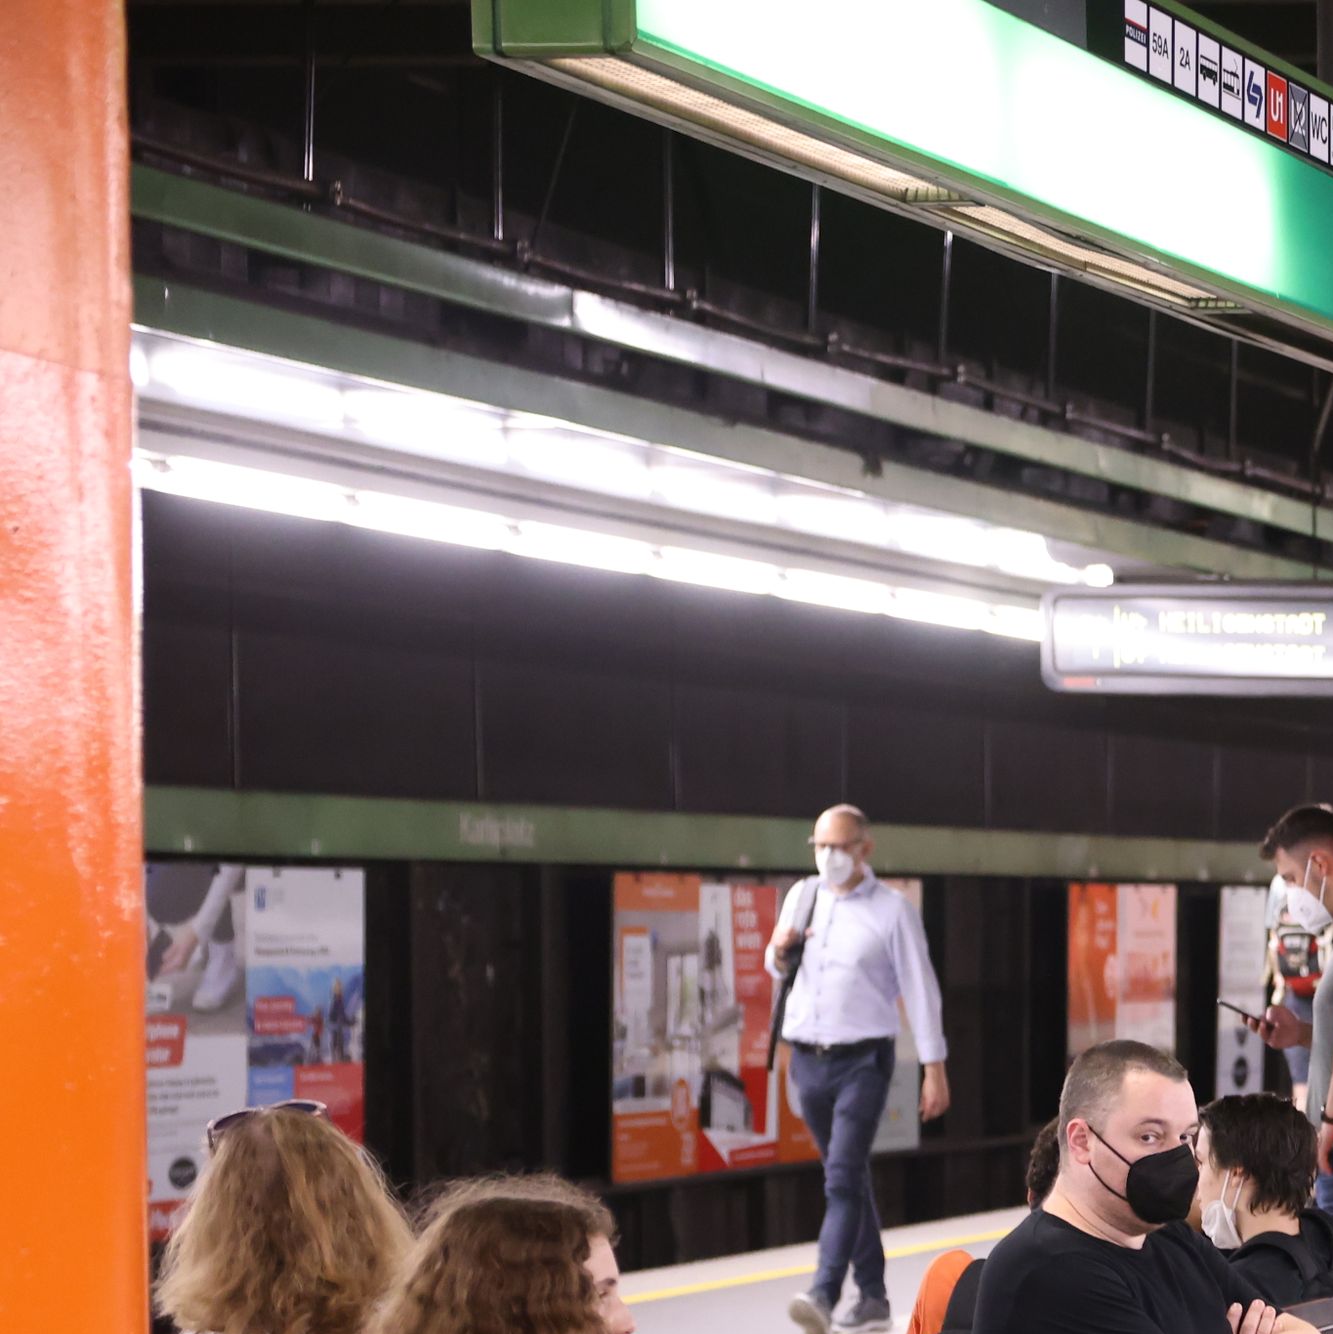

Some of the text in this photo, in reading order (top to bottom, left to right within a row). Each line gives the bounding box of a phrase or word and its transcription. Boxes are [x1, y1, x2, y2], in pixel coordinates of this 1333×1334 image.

[1125, 23, 1147, 45] POLIZEI
[1152, 32, 1169, 60] 59A
[1179, 47, 1191, 71] 2A
[1270, 87, 1284, 124] U1
[1310, 111, 1328, 145] WC
